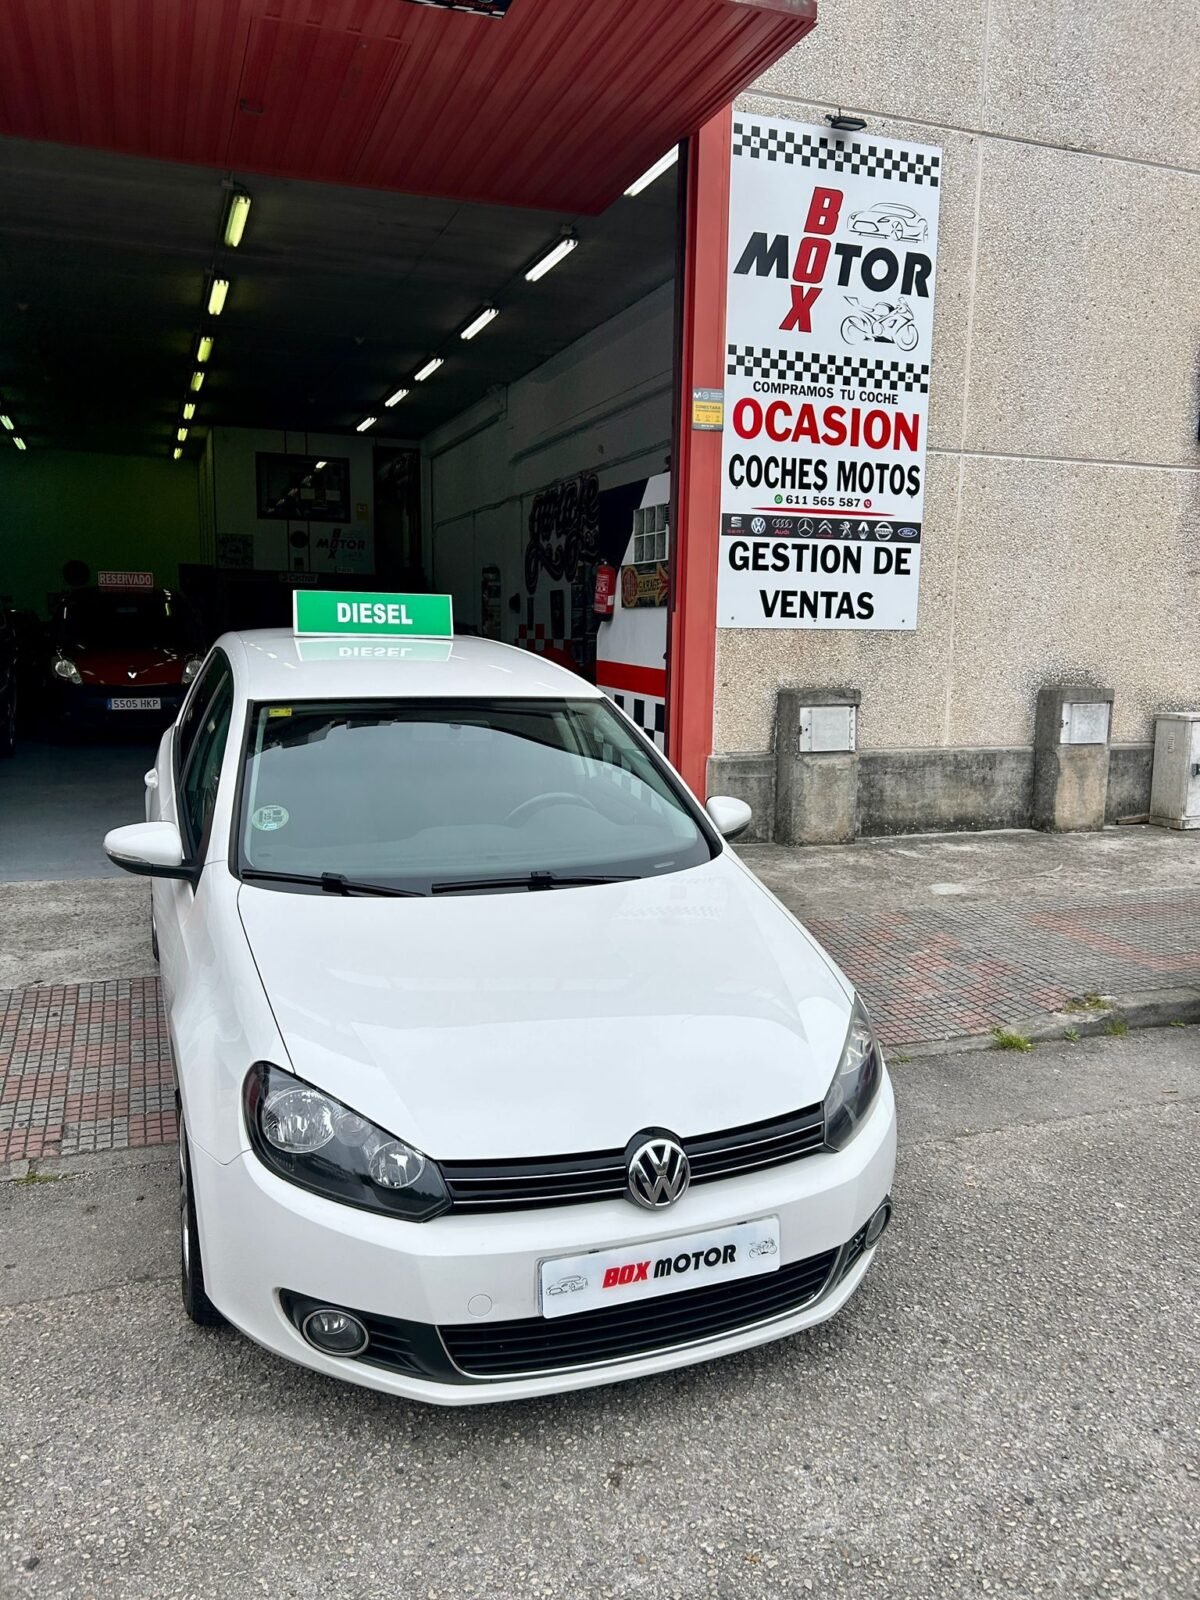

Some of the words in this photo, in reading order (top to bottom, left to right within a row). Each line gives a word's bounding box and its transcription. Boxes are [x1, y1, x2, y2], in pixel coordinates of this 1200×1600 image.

[779, 186, 844, 333] BOX
[753, 381, 834, 398] COMPRAMOS
[840, 389, 855, 400] TU
[859, 391, 899, 405] COCHE
[732, 397, 920, 452] OCASION
[728, 453, 828, 491] COCHES
[837, 460, 921, 496] MOTOS
[786, 495, 808, 504] 611
[813, 496, 835, 506] 565
[839, 498, 861, 507] 587
[728, 541, 862, 575] GESTION
[873, 546, 912, 575] DE
[99, 573, 152, 586] RESERVADO
[337, 602, 413, 625] DIESEL
[759, 590, 874, 620] VENTAS
[114, 699, 138, 709] 5505
[141, 699, 158, 708] HKP
[602, 1260, 652, 1288] BOX
[653, 1244, 736, 1278] MOTOR
